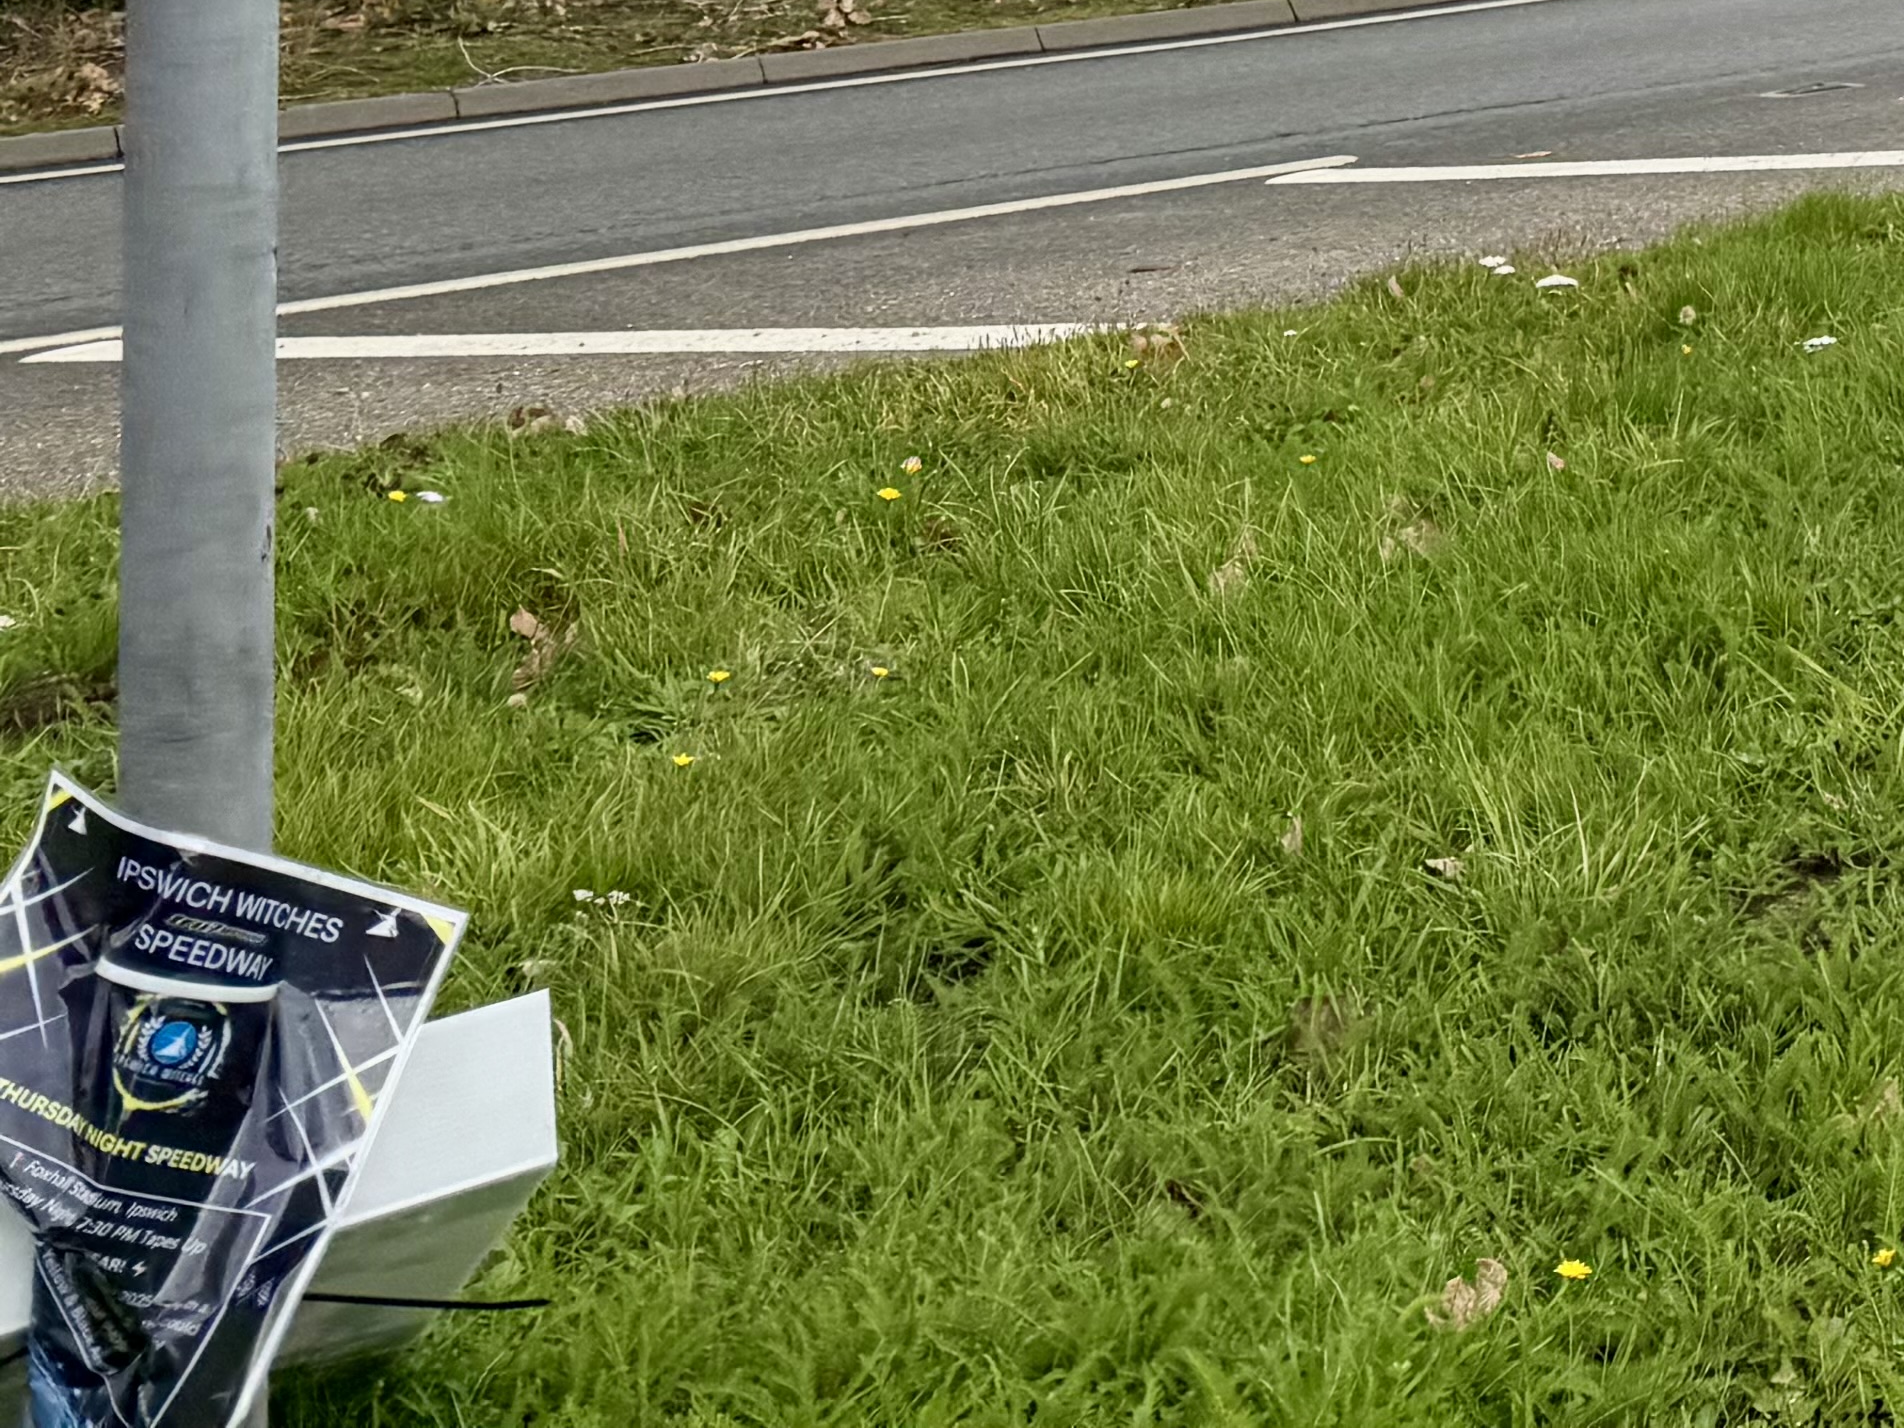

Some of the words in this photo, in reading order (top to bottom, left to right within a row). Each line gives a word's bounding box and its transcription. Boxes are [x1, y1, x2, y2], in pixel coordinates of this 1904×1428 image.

[116, 856, 234, 913] IPSWICH
[235, 892, 344, 943] WITCHES
[134, 924, 273, 981] SPEEDWAY
[85, 1123, 147, 1161] NIGHT
[144, 1144, 256, 1180] SPEEDWAY
[75, 1216, 113, 1237] 7:30
[109, 1221, 144, 1243] PM
[180, 1237, 207, 1256] Up
[125, 1201, 179, 1223] Ipswich
